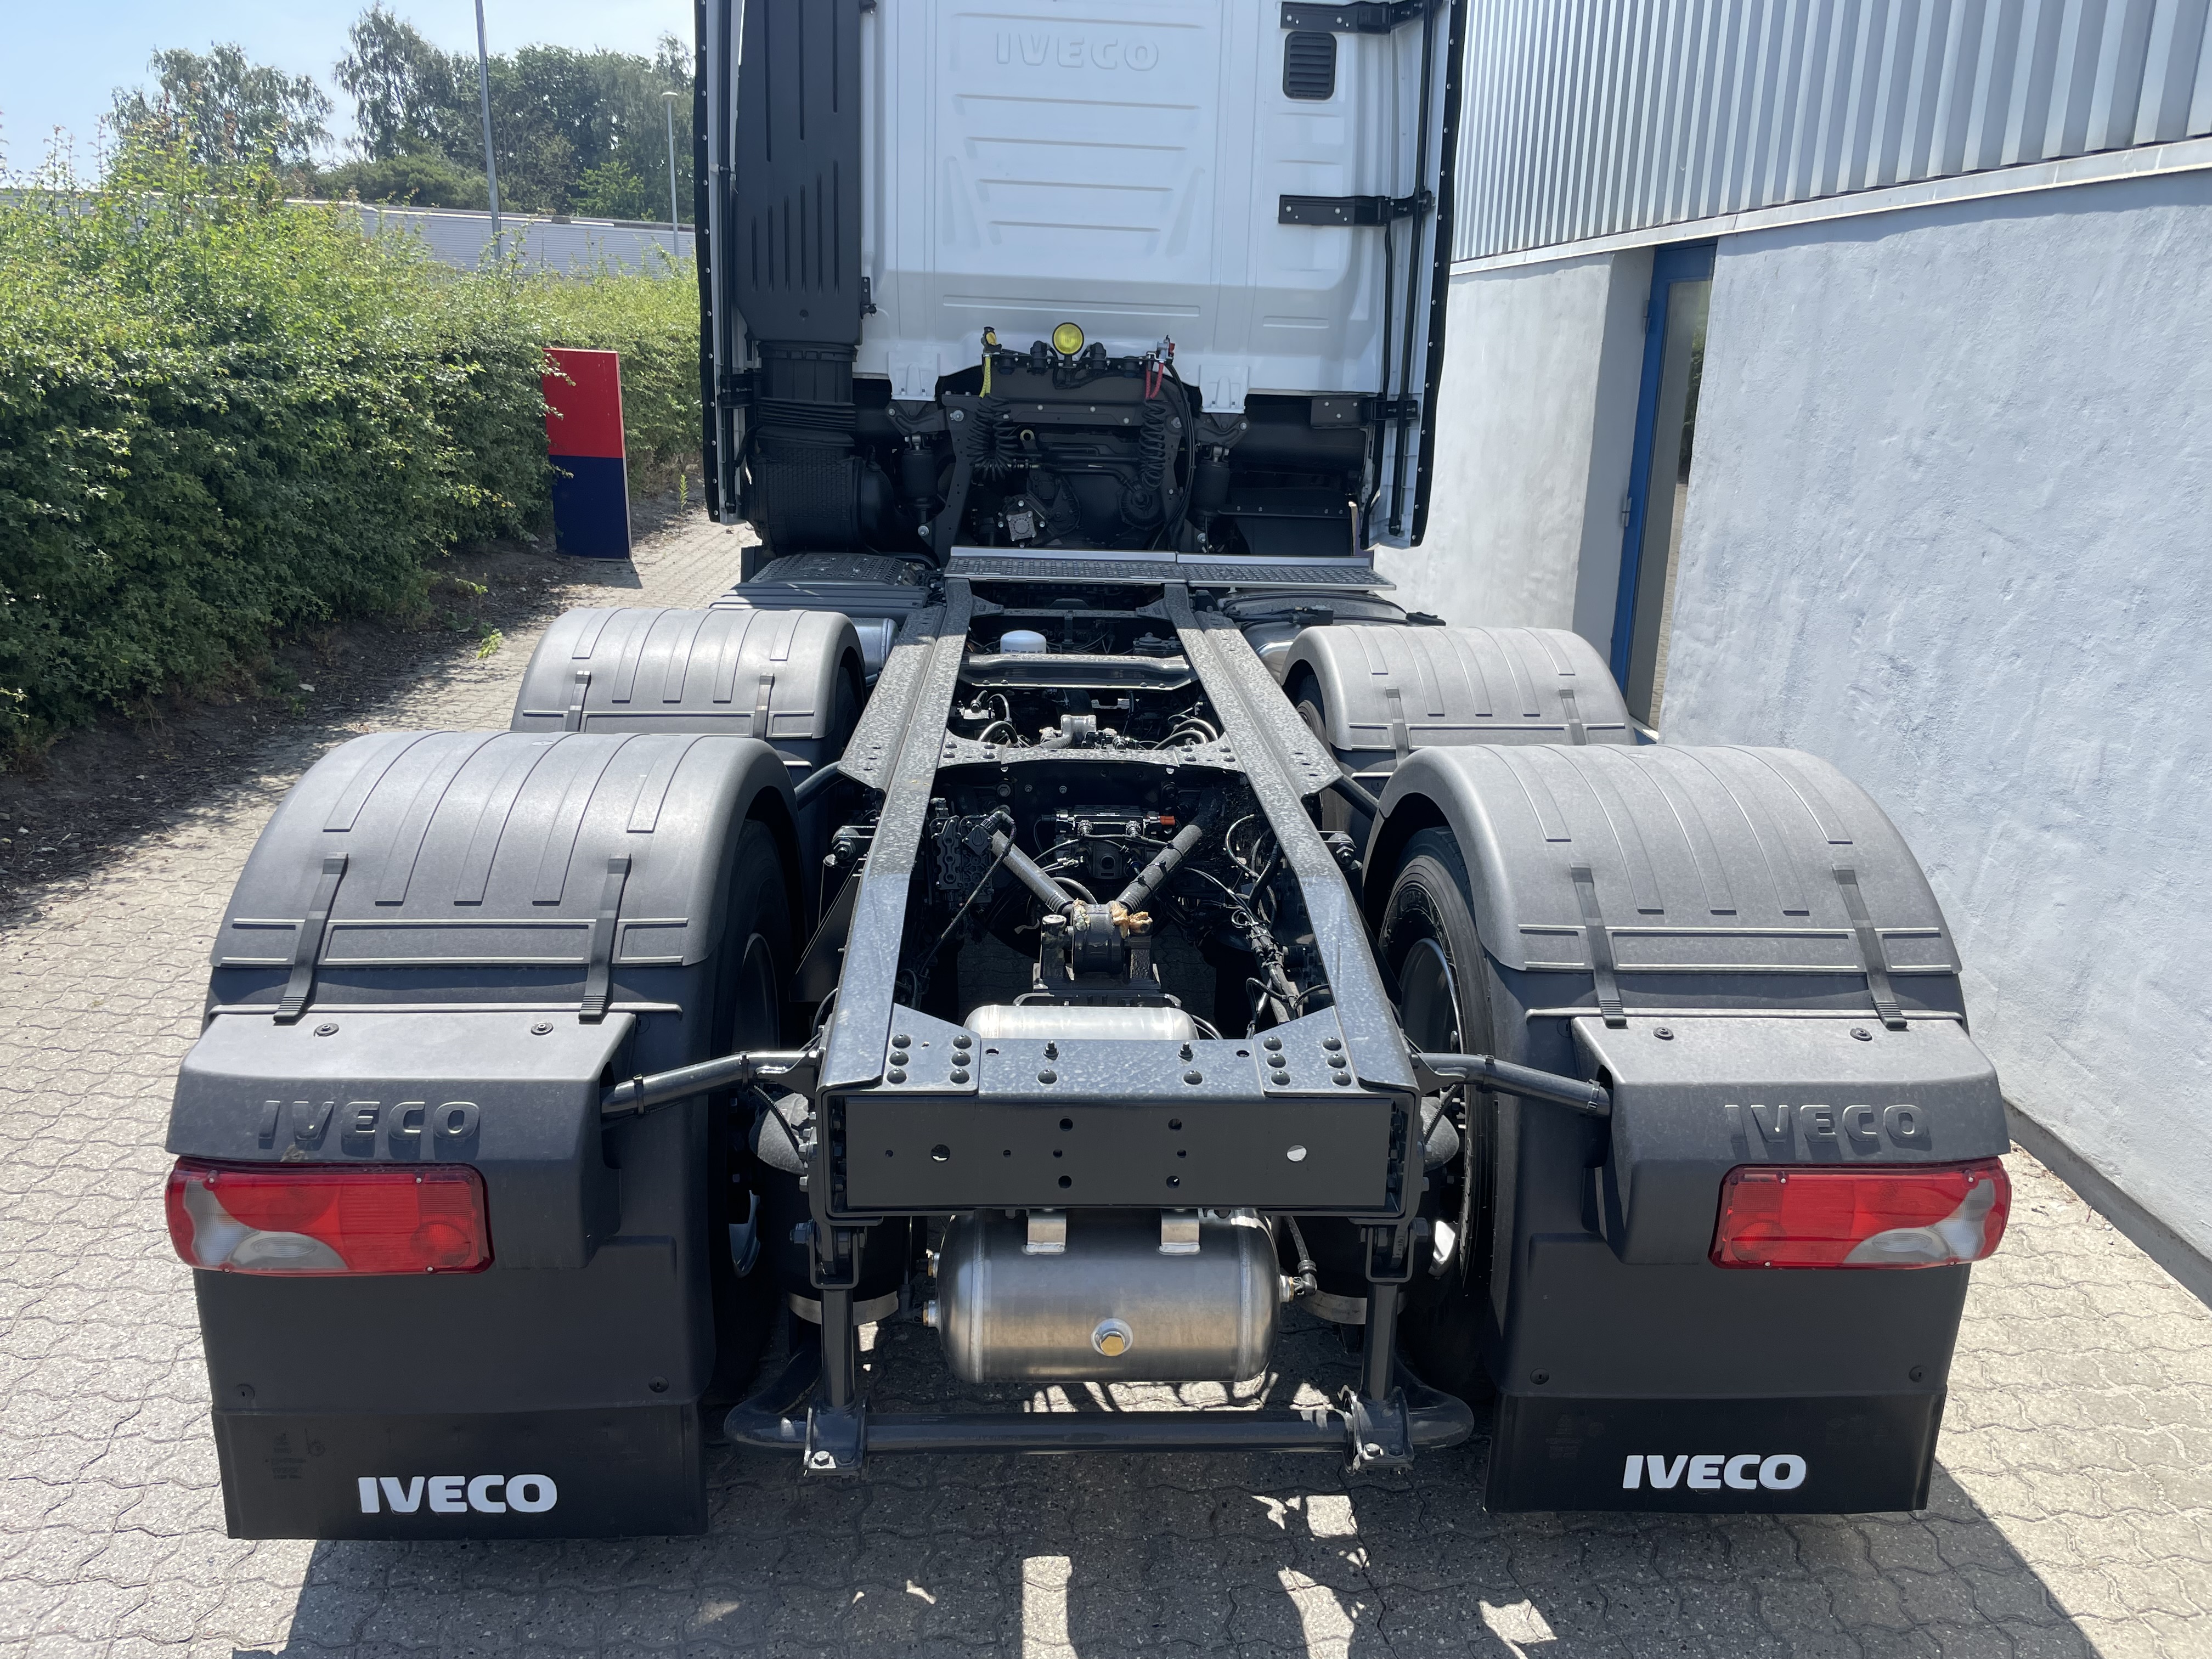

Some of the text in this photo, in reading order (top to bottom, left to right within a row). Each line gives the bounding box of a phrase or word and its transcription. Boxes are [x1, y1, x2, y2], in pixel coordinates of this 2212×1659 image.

[996, 31, 1159, 71] IVECO
[258, 1100, 480, 1141] IVECO
[1724, 1104, 1924, 1143] IVECO
[1622, 1454, 1807, 1489] IVECO
[358, 1474, 557, 1514] IVECO
